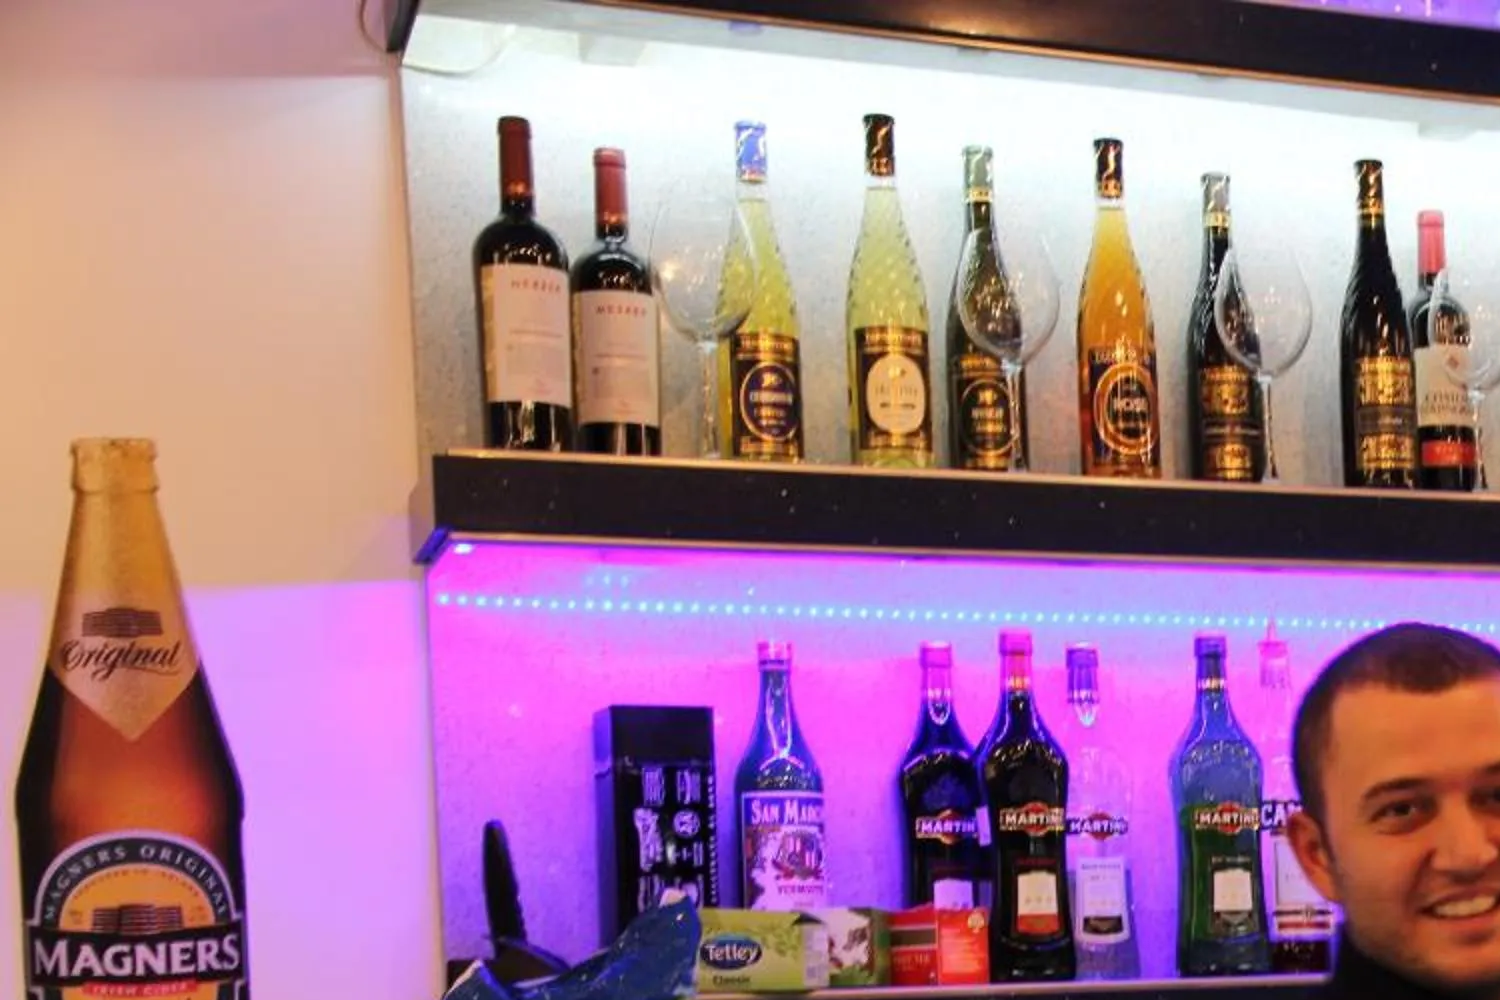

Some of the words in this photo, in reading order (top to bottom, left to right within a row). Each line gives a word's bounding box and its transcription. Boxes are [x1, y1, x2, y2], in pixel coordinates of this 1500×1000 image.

[60, 639, 182, 682] Original
[921, 818, 977, 834] MARTIN
[33, 932, 241, 979] MAGNERS
[703, 942, 760, 965] Tetley
